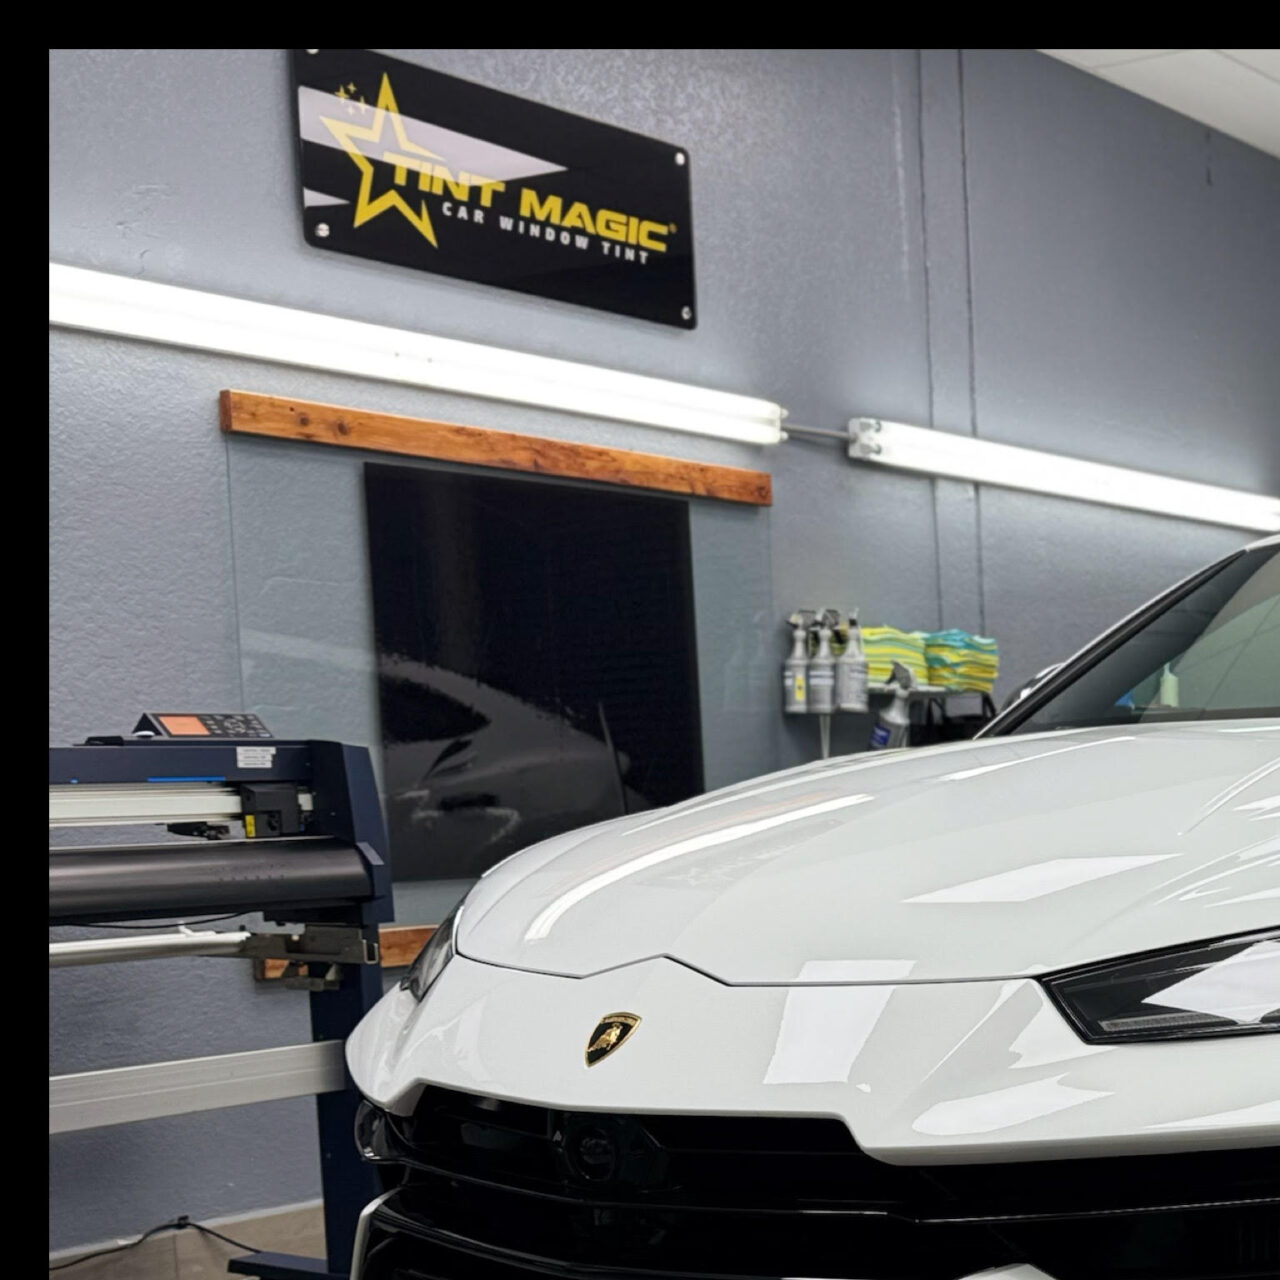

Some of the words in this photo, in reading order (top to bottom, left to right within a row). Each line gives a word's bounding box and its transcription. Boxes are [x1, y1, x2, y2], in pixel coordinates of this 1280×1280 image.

[383, 152, 506, 208] TINT
[519, 188, 669, 252] MAGIC
[442, 201, 485, 224] CAR
[499, 215, 589, 250] WINDOW
[602, 241, 649, 265] TINT
